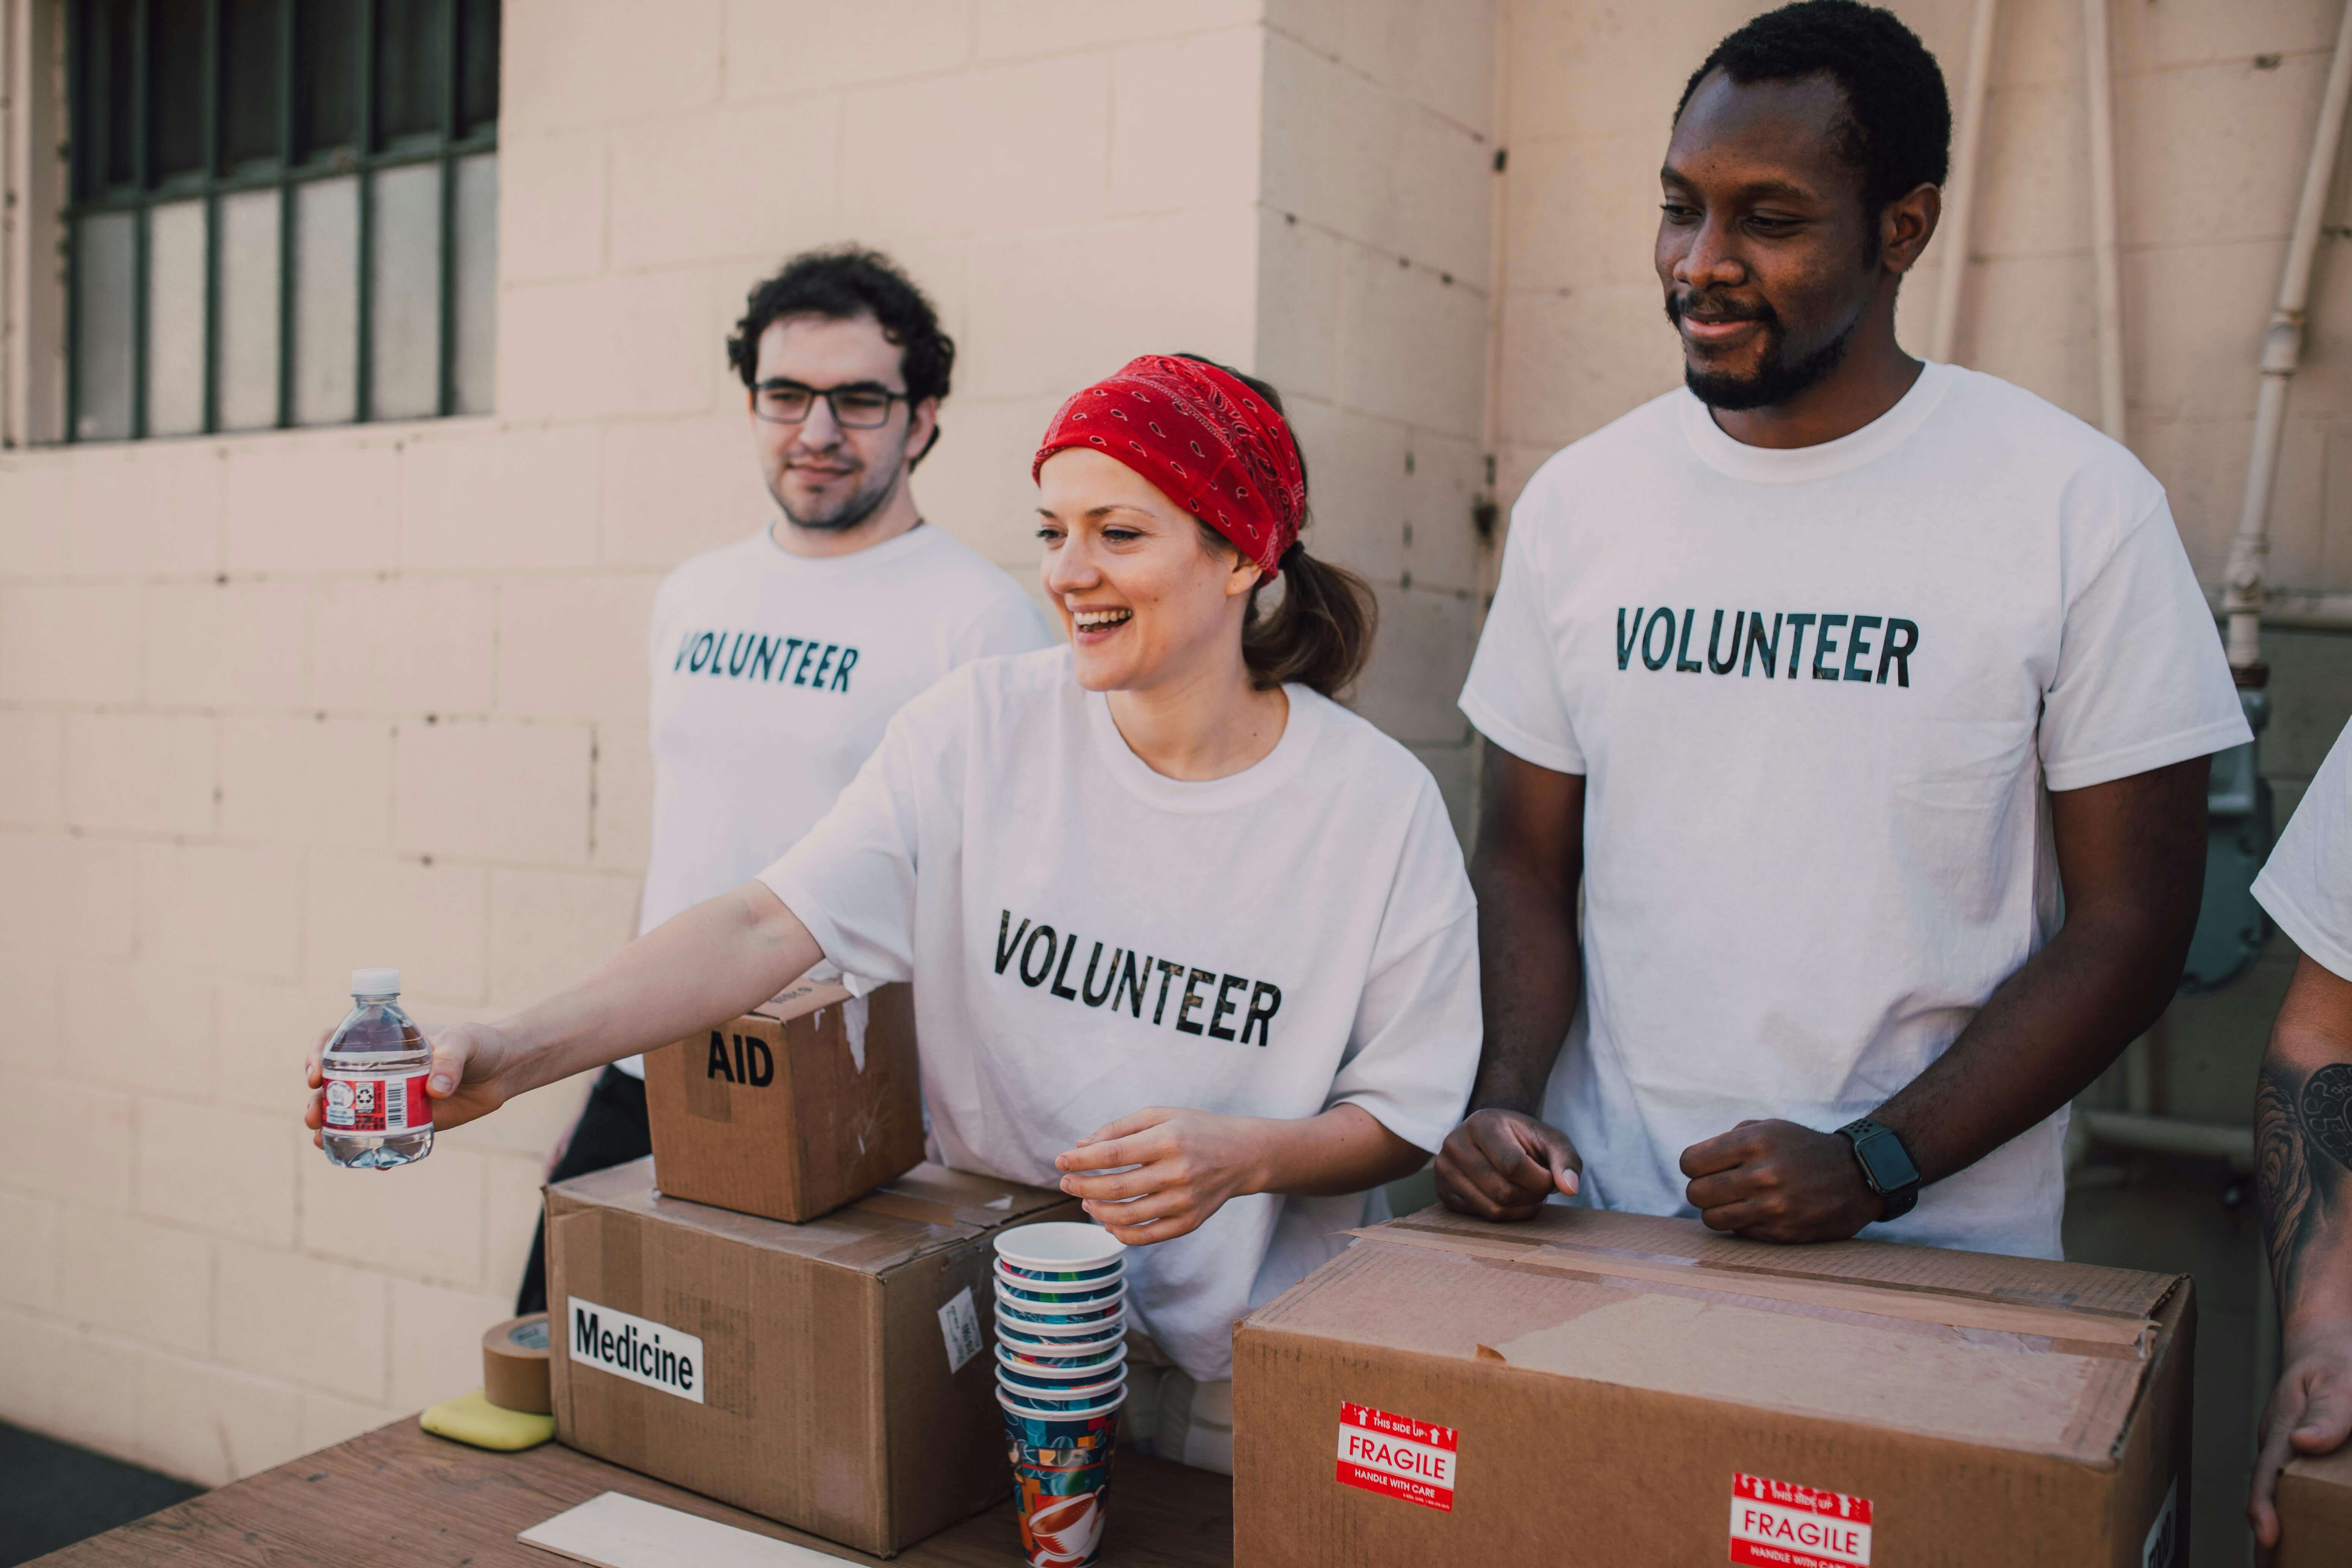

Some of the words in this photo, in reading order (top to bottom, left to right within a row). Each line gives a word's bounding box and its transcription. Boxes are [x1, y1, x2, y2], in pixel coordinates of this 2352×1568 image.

[673, 631, 859, 693] VOLUNTEER
[1616, 607, 1919, 688] VOLUNTEER
[994, 909, 1282, 1047] VOLUNTEER
[707, 1030, 774, 1088] AID
[576, 1308, 693, 1390] Medicine
[1373, 1417, 1391, 1430] THIS
[1392, 1423, 1411, 1435] SIDE
[1413, 1427, 1424, 1437] UP
[1349, 1435, 1446, 1480] FRAGILE
[1355, 1468, 1387, 1486] HANDLE
[1390, 1478, 1410, 1492] WITH
[1411, 1484, 1435, 1498] CARE
[1772, 1490, 1793, 1502] THIS
[1793, 1492, 1818, 1508] SIDE
[1818, 1498, 1833, 1510] UP
[1744, 1510, 1858, 1555] FRAGILE
[1750, 1545, 1791, 1563] HANDLE
[1792, 1554, 1818, 1568] WITH
